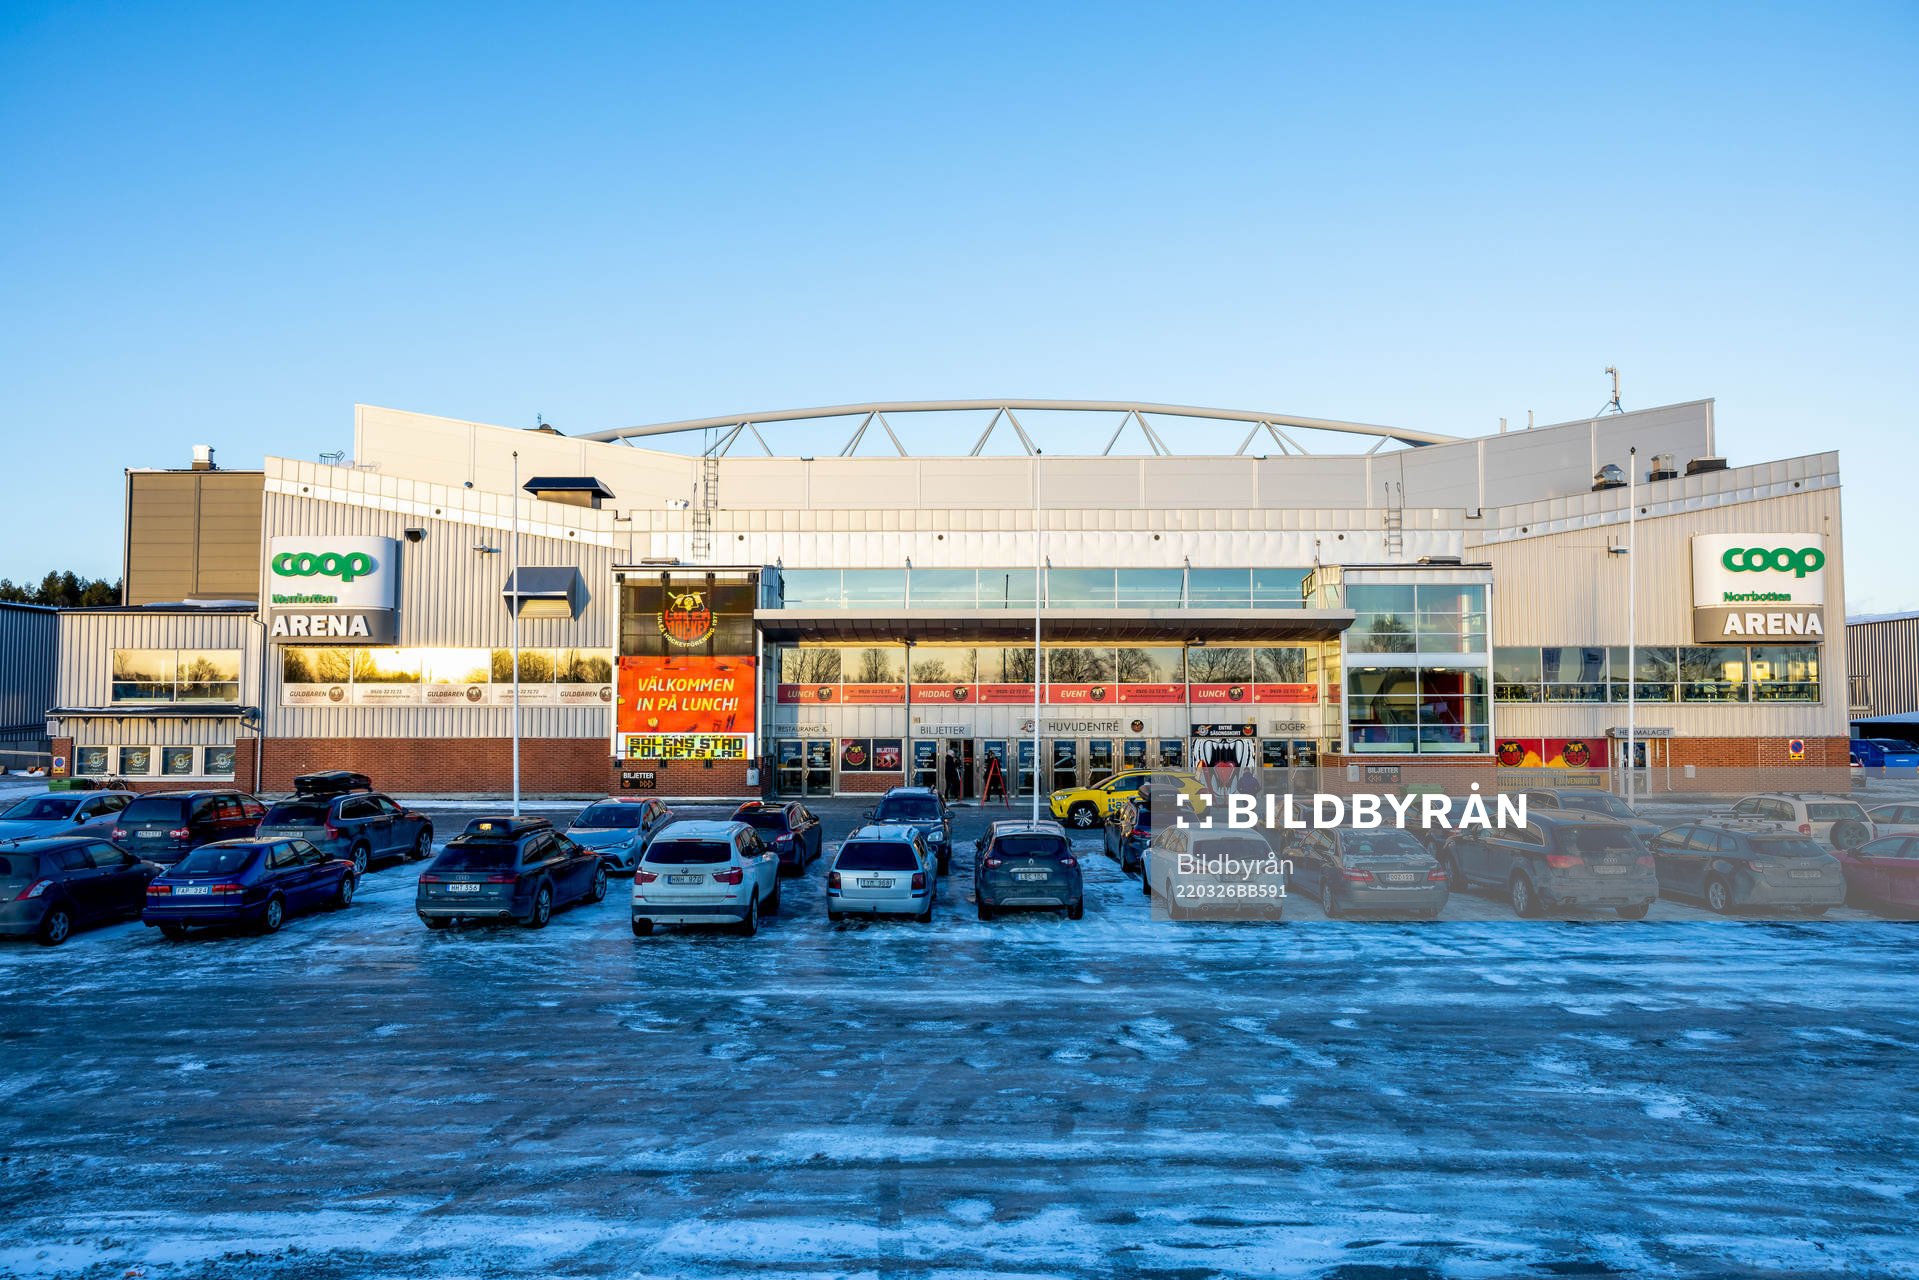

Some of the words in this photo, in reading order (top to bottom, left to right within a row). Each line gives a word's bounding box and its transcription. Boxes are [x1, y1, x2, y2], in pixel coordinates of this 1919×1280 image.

[272, 552, 372, 582] coop
[1723, 547, 1825, 579] coop
[1723, 590, 1792, 602] Norrbotten
[271, 615, 370, 637] ARENA
[1723, 613, 1824, 635] ARENA
[638, 676, 735, 692] VÄLKOMMEN
[787, 690, 815, 698] LUNCH
[918, 690, 951, 698] MIDDAG
[1060, 690, 1088, 698] EVENT
[1198, 690, 1226, 698] LUNCH
[636, 698, 654, 711] IN
[657, 694, 678, 711] PÅ
[681, 698, 739, 711] LUNCH!
[777, 725, 820, 733] RESTAURANG
[920, 726, 965, 735] BILJETTER
[1048, 721, 1119, 732] HUVUDENTRÉ
[1275, 723, 1306, 731] LOGER
[629, 738, 695, 749] SOLENS
[699, 738, 743, 750] STAD
[710, 750, 743, 758] LAG
